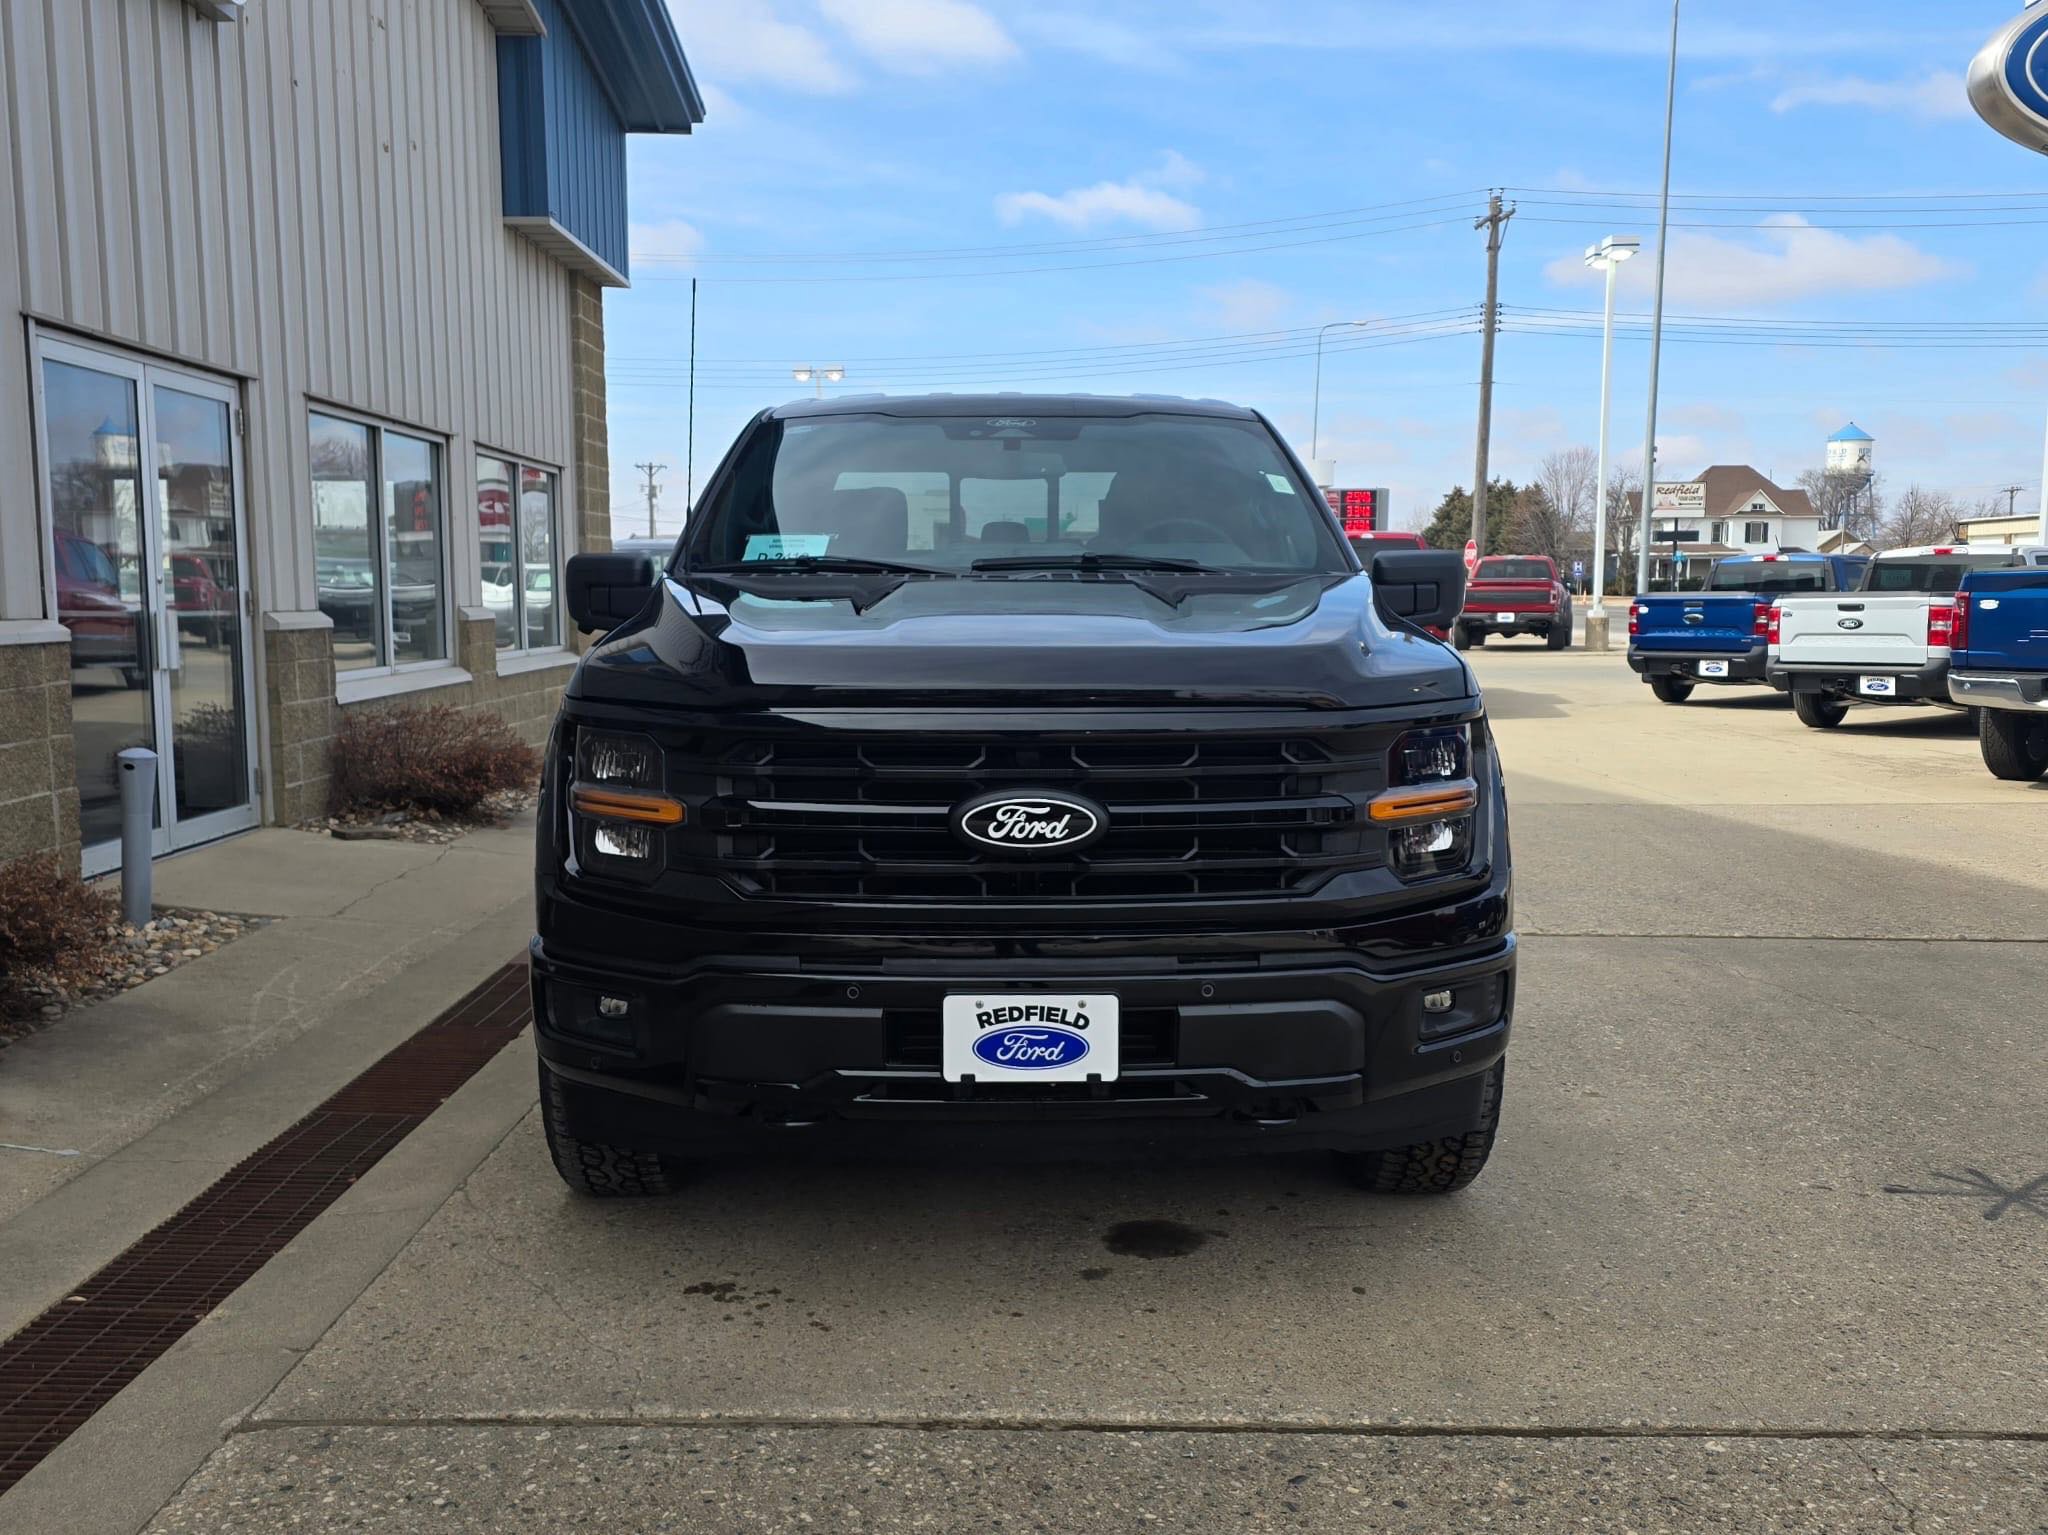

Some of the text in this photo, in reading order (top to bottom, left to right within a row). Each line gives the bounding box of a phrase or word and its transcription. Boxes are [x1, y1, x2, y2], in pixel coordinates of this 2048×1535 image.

[1656, 484, 1700, 498] Redfield
[987, 804, 1071, 839] Ford
[975, 1005, 1090, 1031] REDFIELD
[996, 1033, 1065, 1062] Ford
